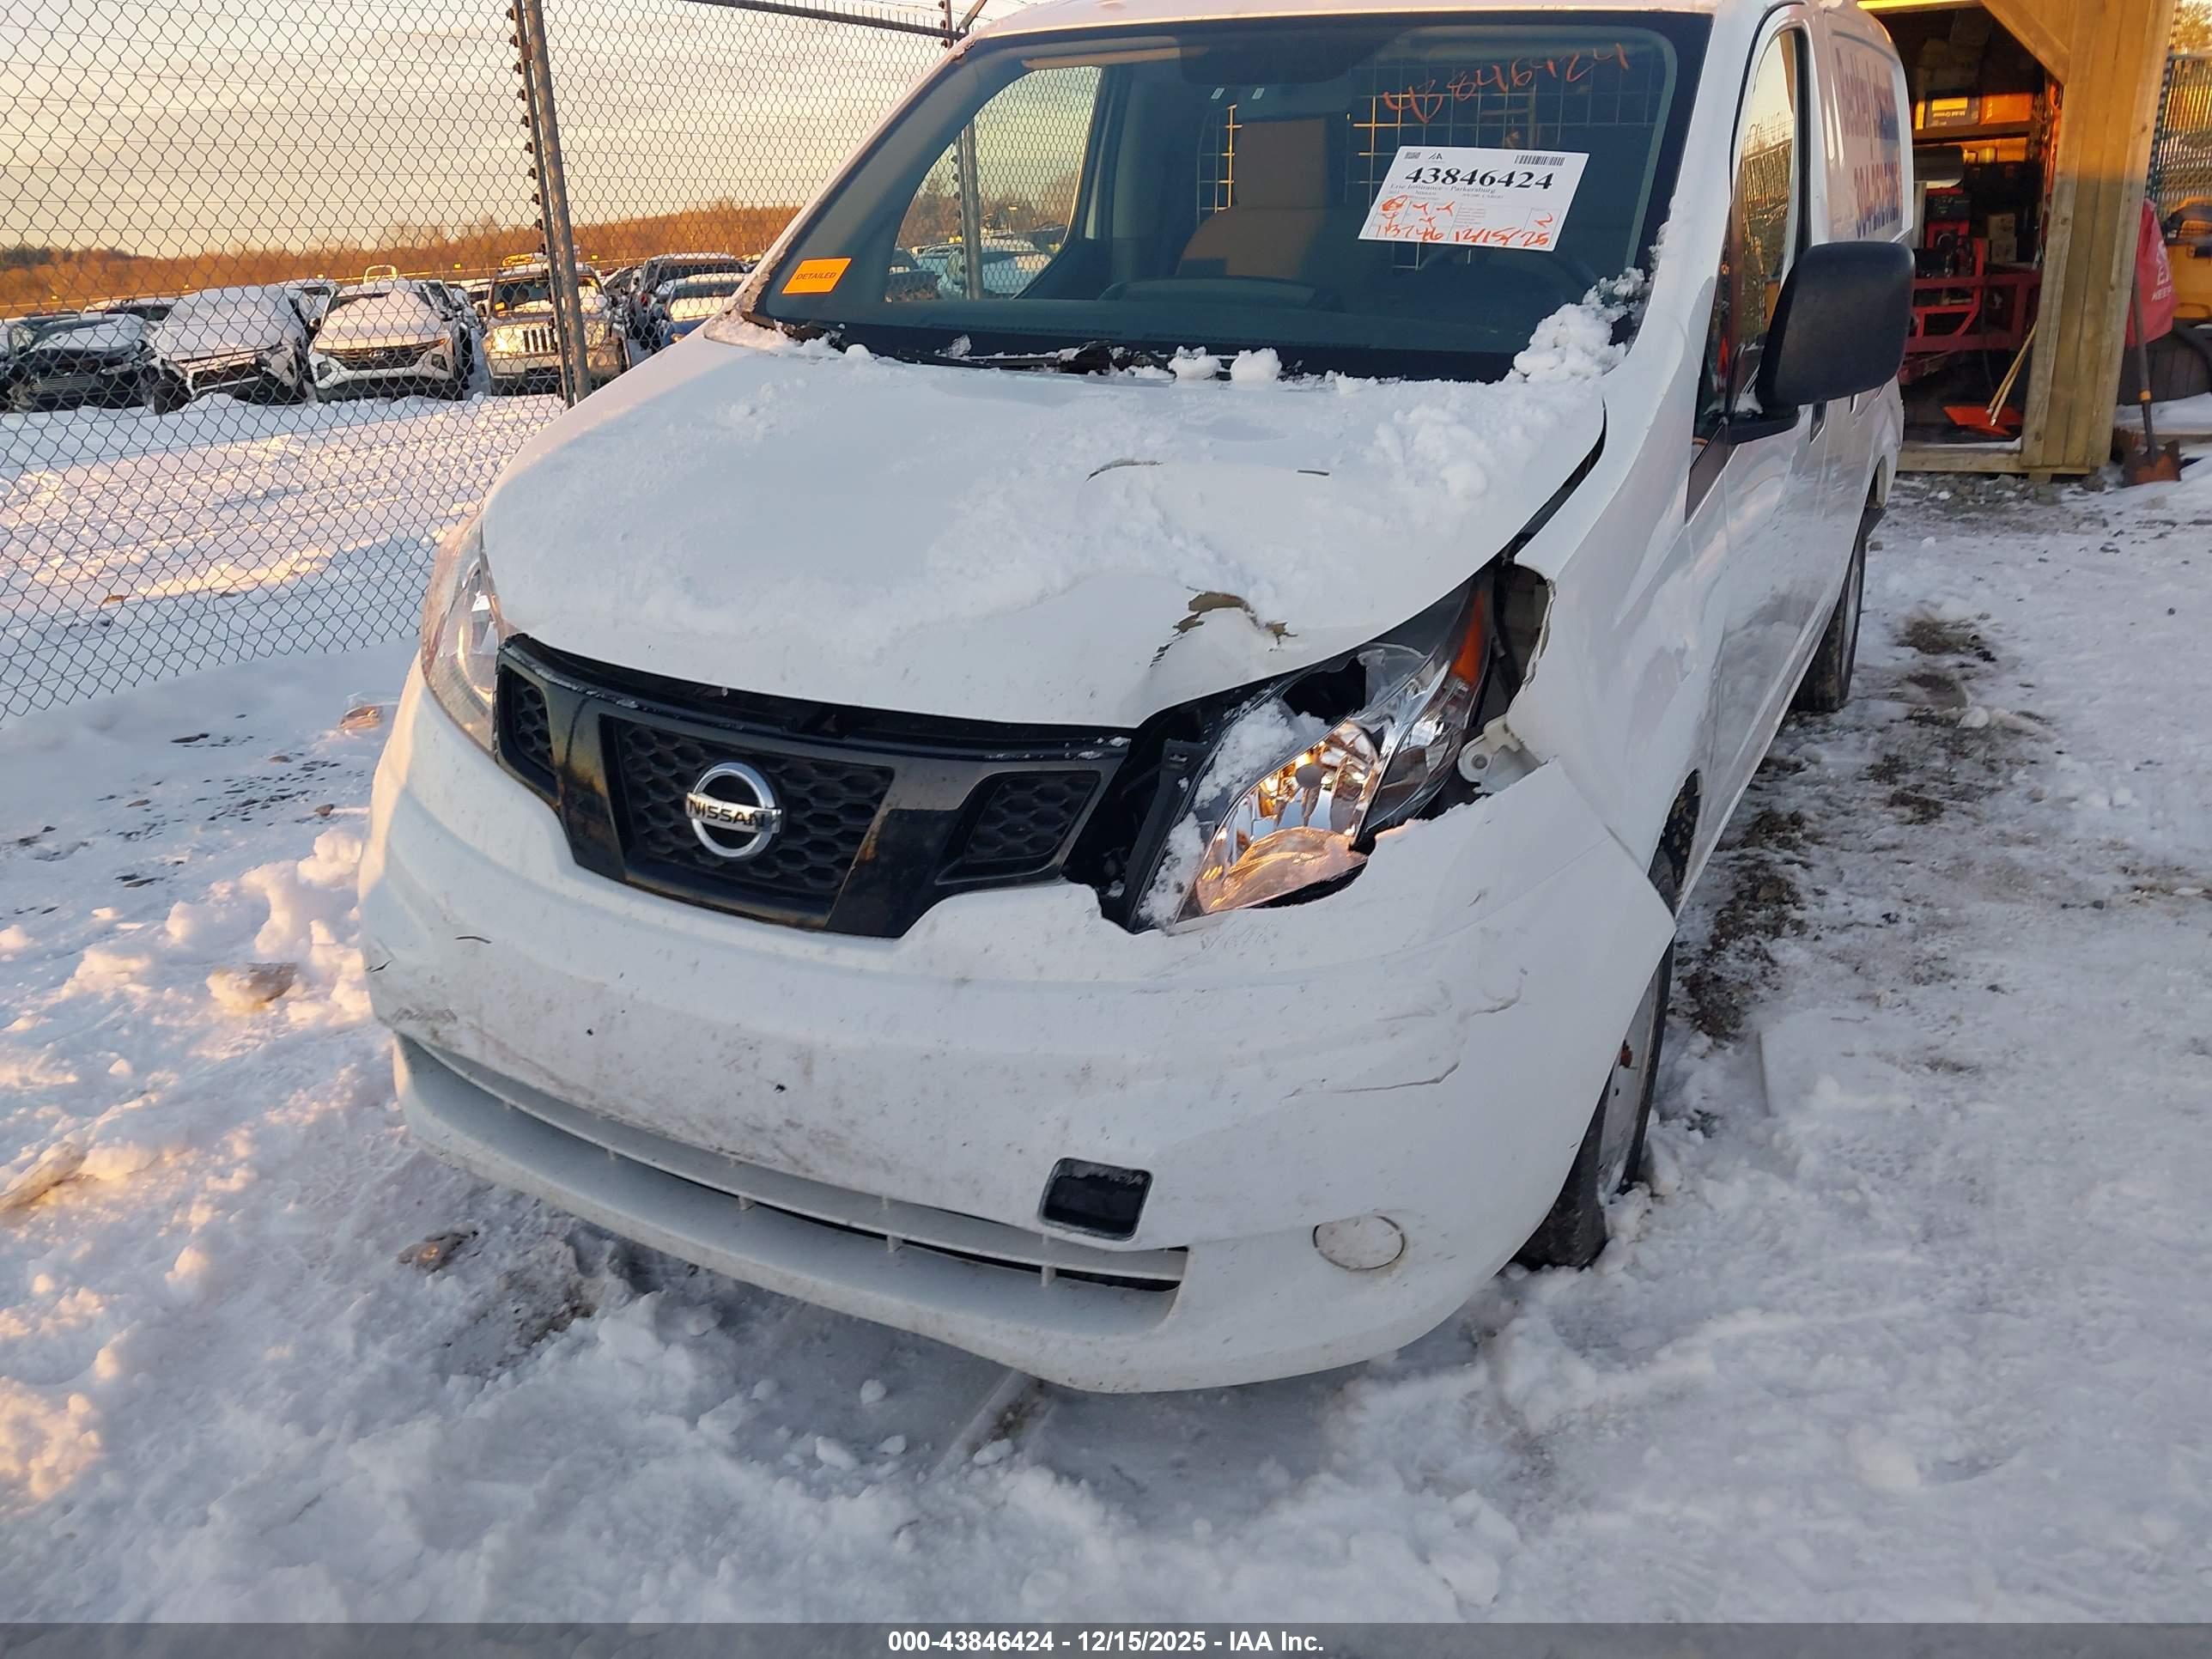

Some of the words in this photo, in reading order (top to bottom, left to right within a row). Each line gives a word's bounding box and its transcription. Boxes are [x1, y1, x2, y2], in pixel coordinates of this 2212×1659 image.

[1405, 166, 1554, 190] 43846424
[795, 271, 837, 281] DETAILED
[687, 797, 768, 827] NISSAN
